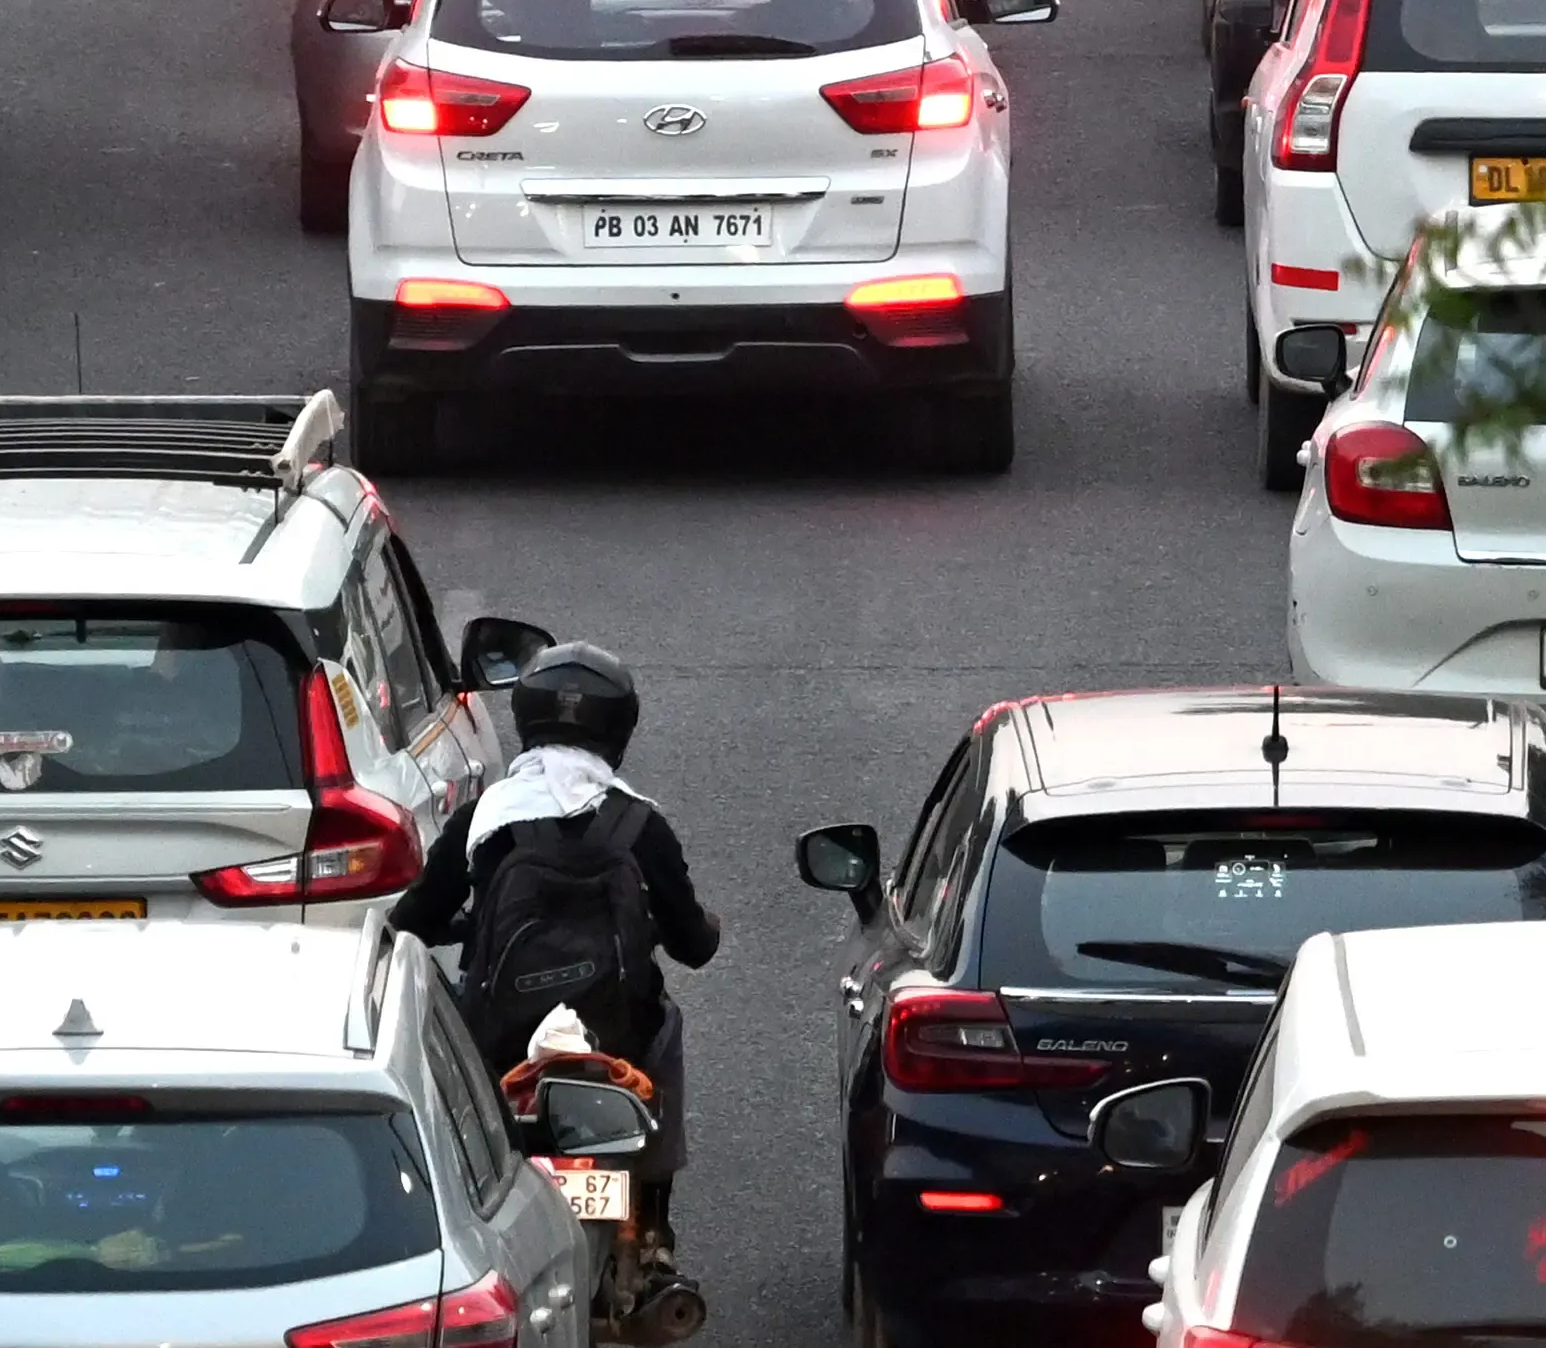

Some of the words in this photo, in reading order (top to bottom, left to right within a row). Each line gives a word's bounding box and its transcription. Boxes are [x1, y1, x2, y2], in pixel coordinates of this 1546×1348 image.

[457, 150, 525, 162] CRETA
[595, 215, 623, 237] PB
[634, 215, 660, 236] 03
[669, 214, 700, 236] AN
[713, 213, 764, 236] 7671
[1036, 1038, 1129, 1051] BALENO
[585, 1175, 611, 1194] 67
